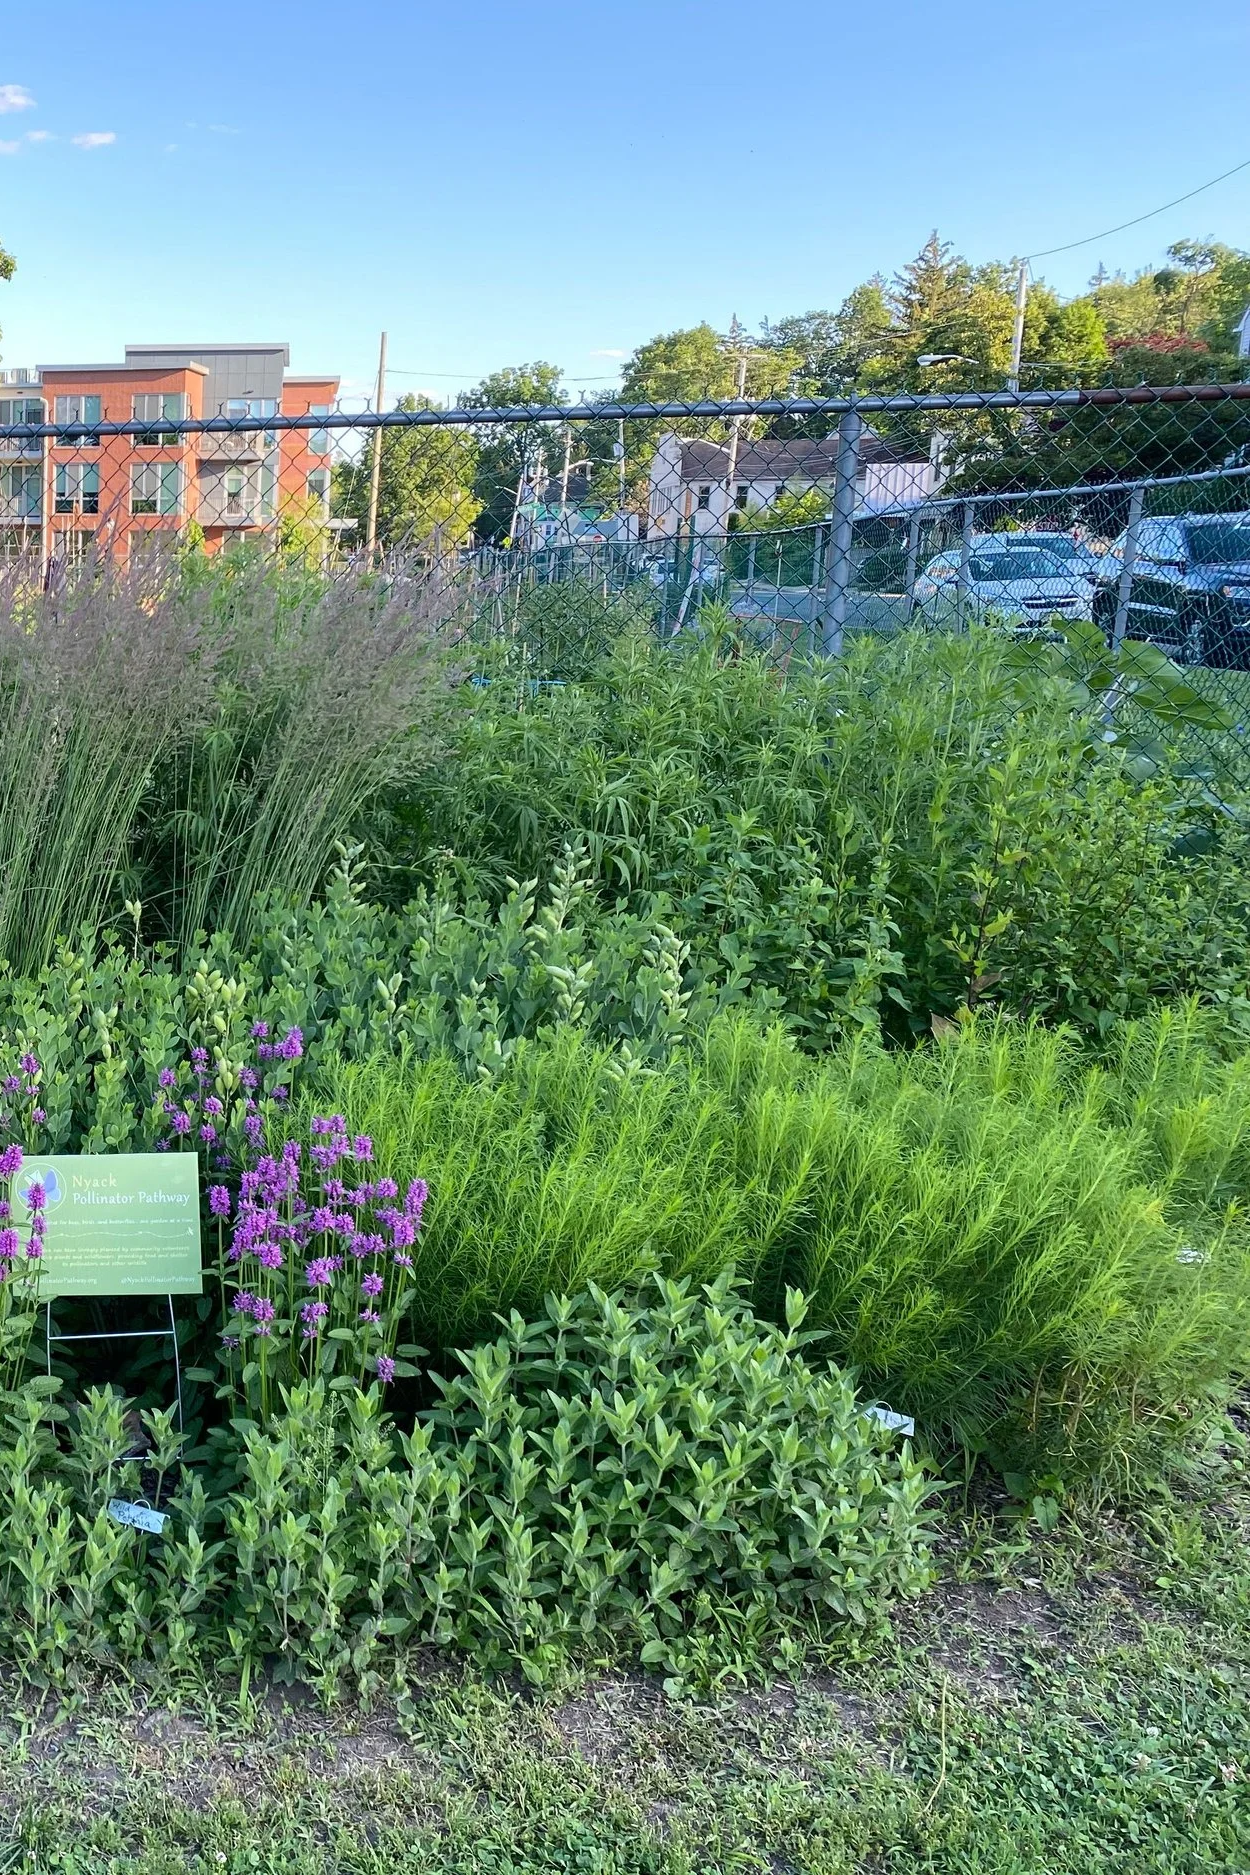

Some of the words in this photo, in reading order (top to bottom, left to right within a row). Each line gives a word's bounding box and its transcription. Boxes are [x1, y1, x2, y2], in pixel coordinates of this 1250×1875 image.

[72, 1172, 117, 1191] Nyack
[72, 1190, 135, 1205] Pollinator
[137, 1189, 191, 1206] Pathway
[150, 1217, 168, 1225] garden
[99, 1246, 121, 1254] planted
[112, 1500, 131, 1512] Wild
